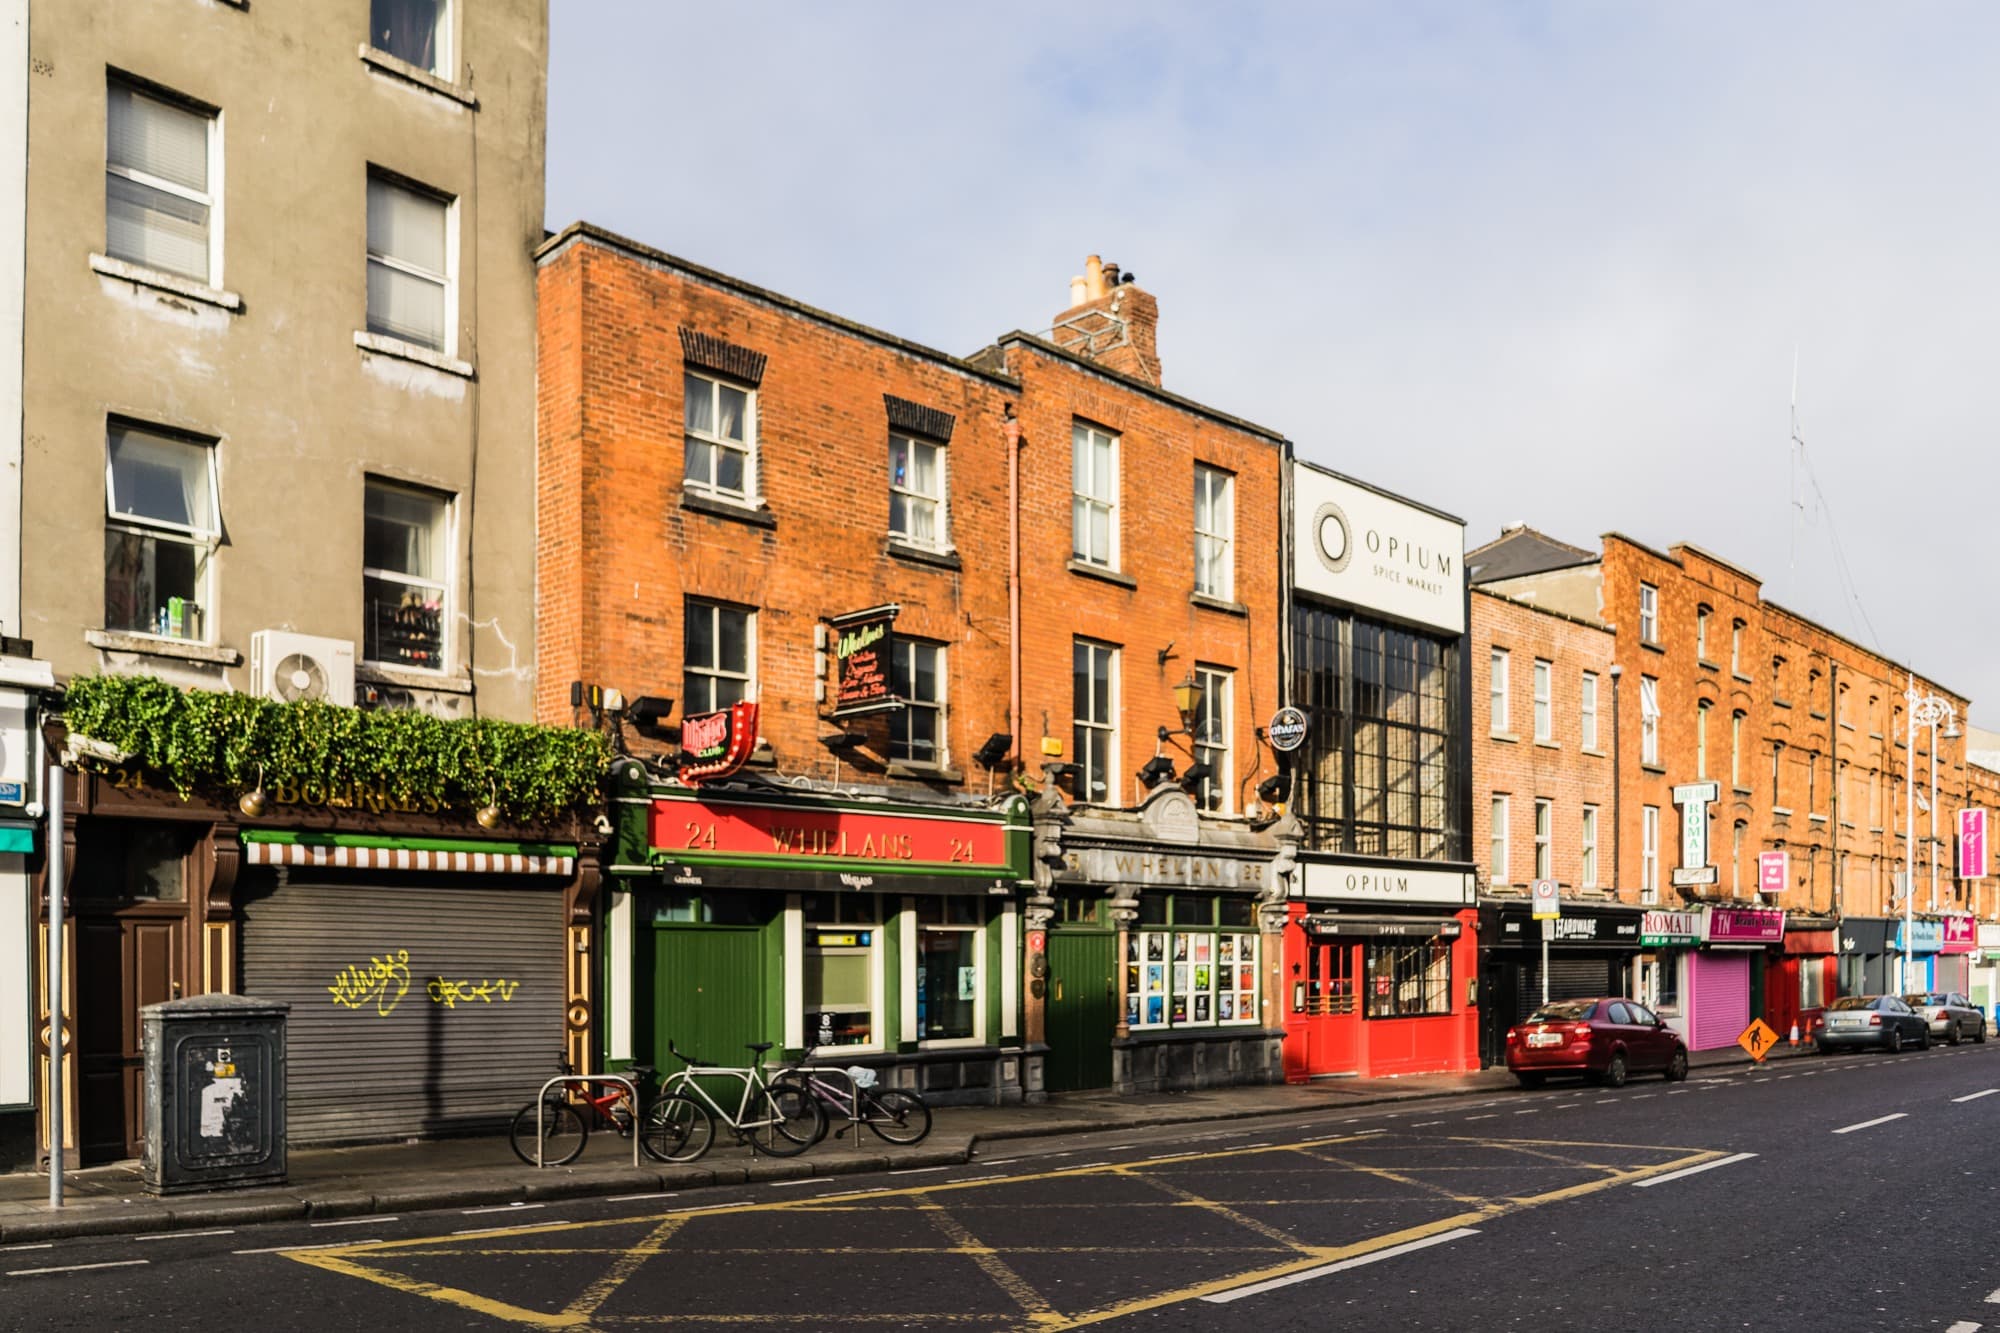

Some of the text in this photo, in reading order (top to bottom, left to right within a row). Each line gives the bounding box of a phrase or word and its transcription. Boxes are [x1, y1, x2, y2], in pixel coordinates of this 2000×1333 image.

[1366, 529, 1451, 577] OPIUM
[1373, 563, 1443, 595] SPICE MARKET
[114, 769, 143, 791] 24
[686, 822, 974, 863] 24 WHELANS 24
[1114, 854, 1220, 879] WHELAN
[1346, 874, 1408, 893] OPIUM
[1555, 918, 1597, 939] HARDWARE
[1645, 912, 1682, 934] ROMA
